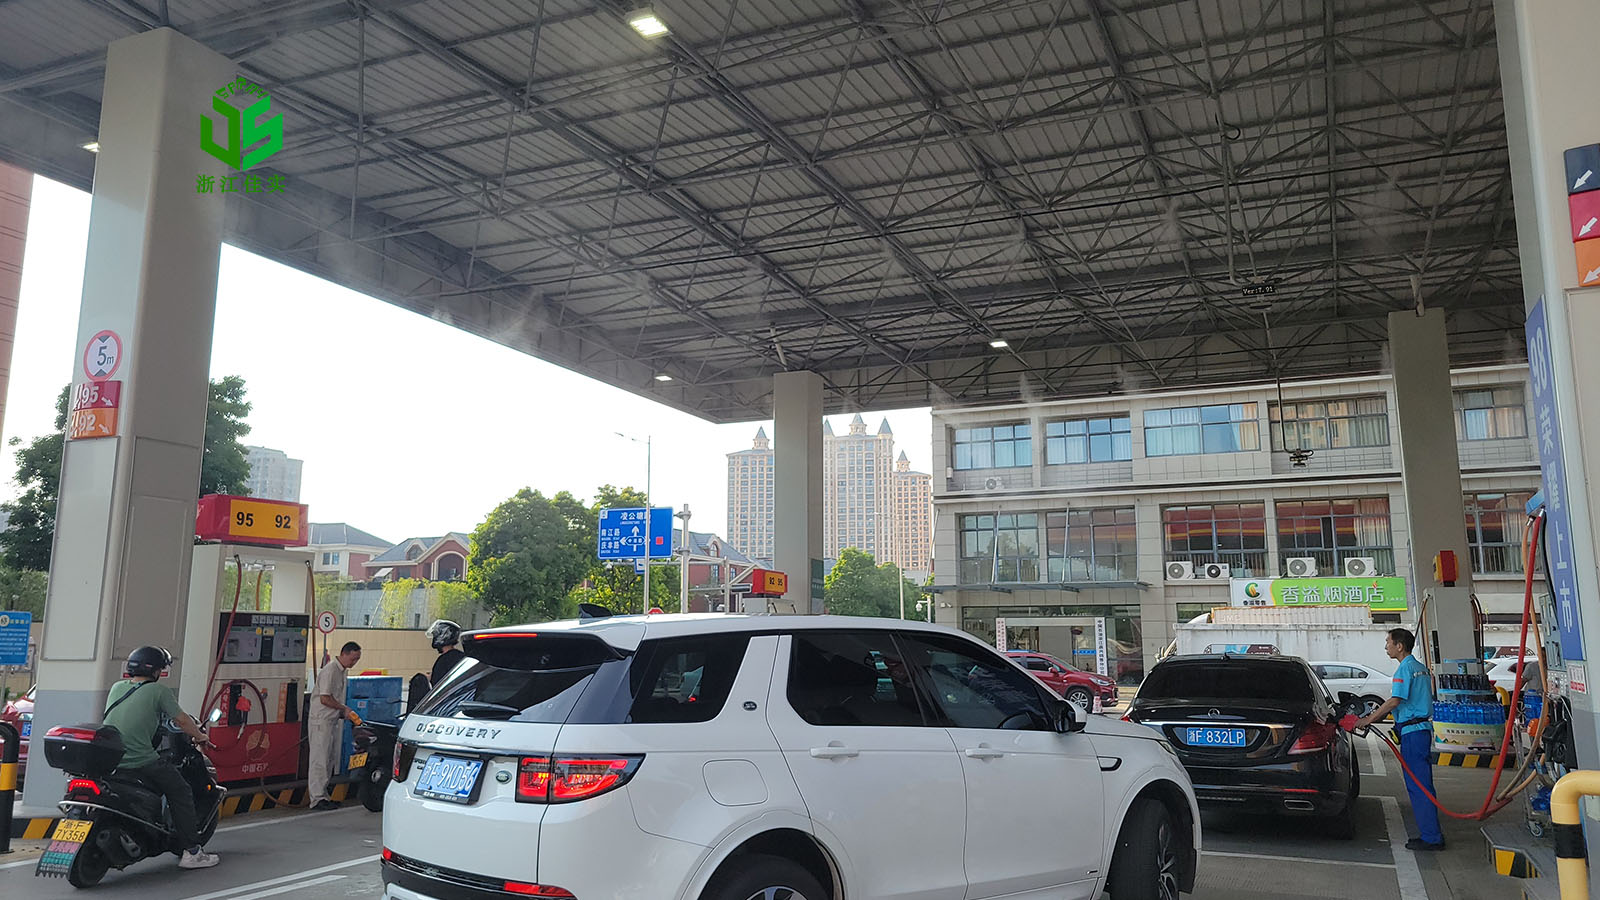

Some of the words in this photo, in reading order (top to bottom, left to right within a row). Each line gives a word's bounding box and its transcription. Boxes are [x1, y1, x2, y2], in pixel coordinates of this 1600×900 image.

[82, 386, 99, 406] 95
[79, 414, 96, 432] 92
[236, 512, 253, 526] 95
[275, 514, 291, 529] 92
[1281, 583, 1384, 604] 香溢烟酒店
[324, 616, 330, 627] 5
[415, 723, 502, 740] DISCOVERY
[55, 829, 85, 841] 7Y358
